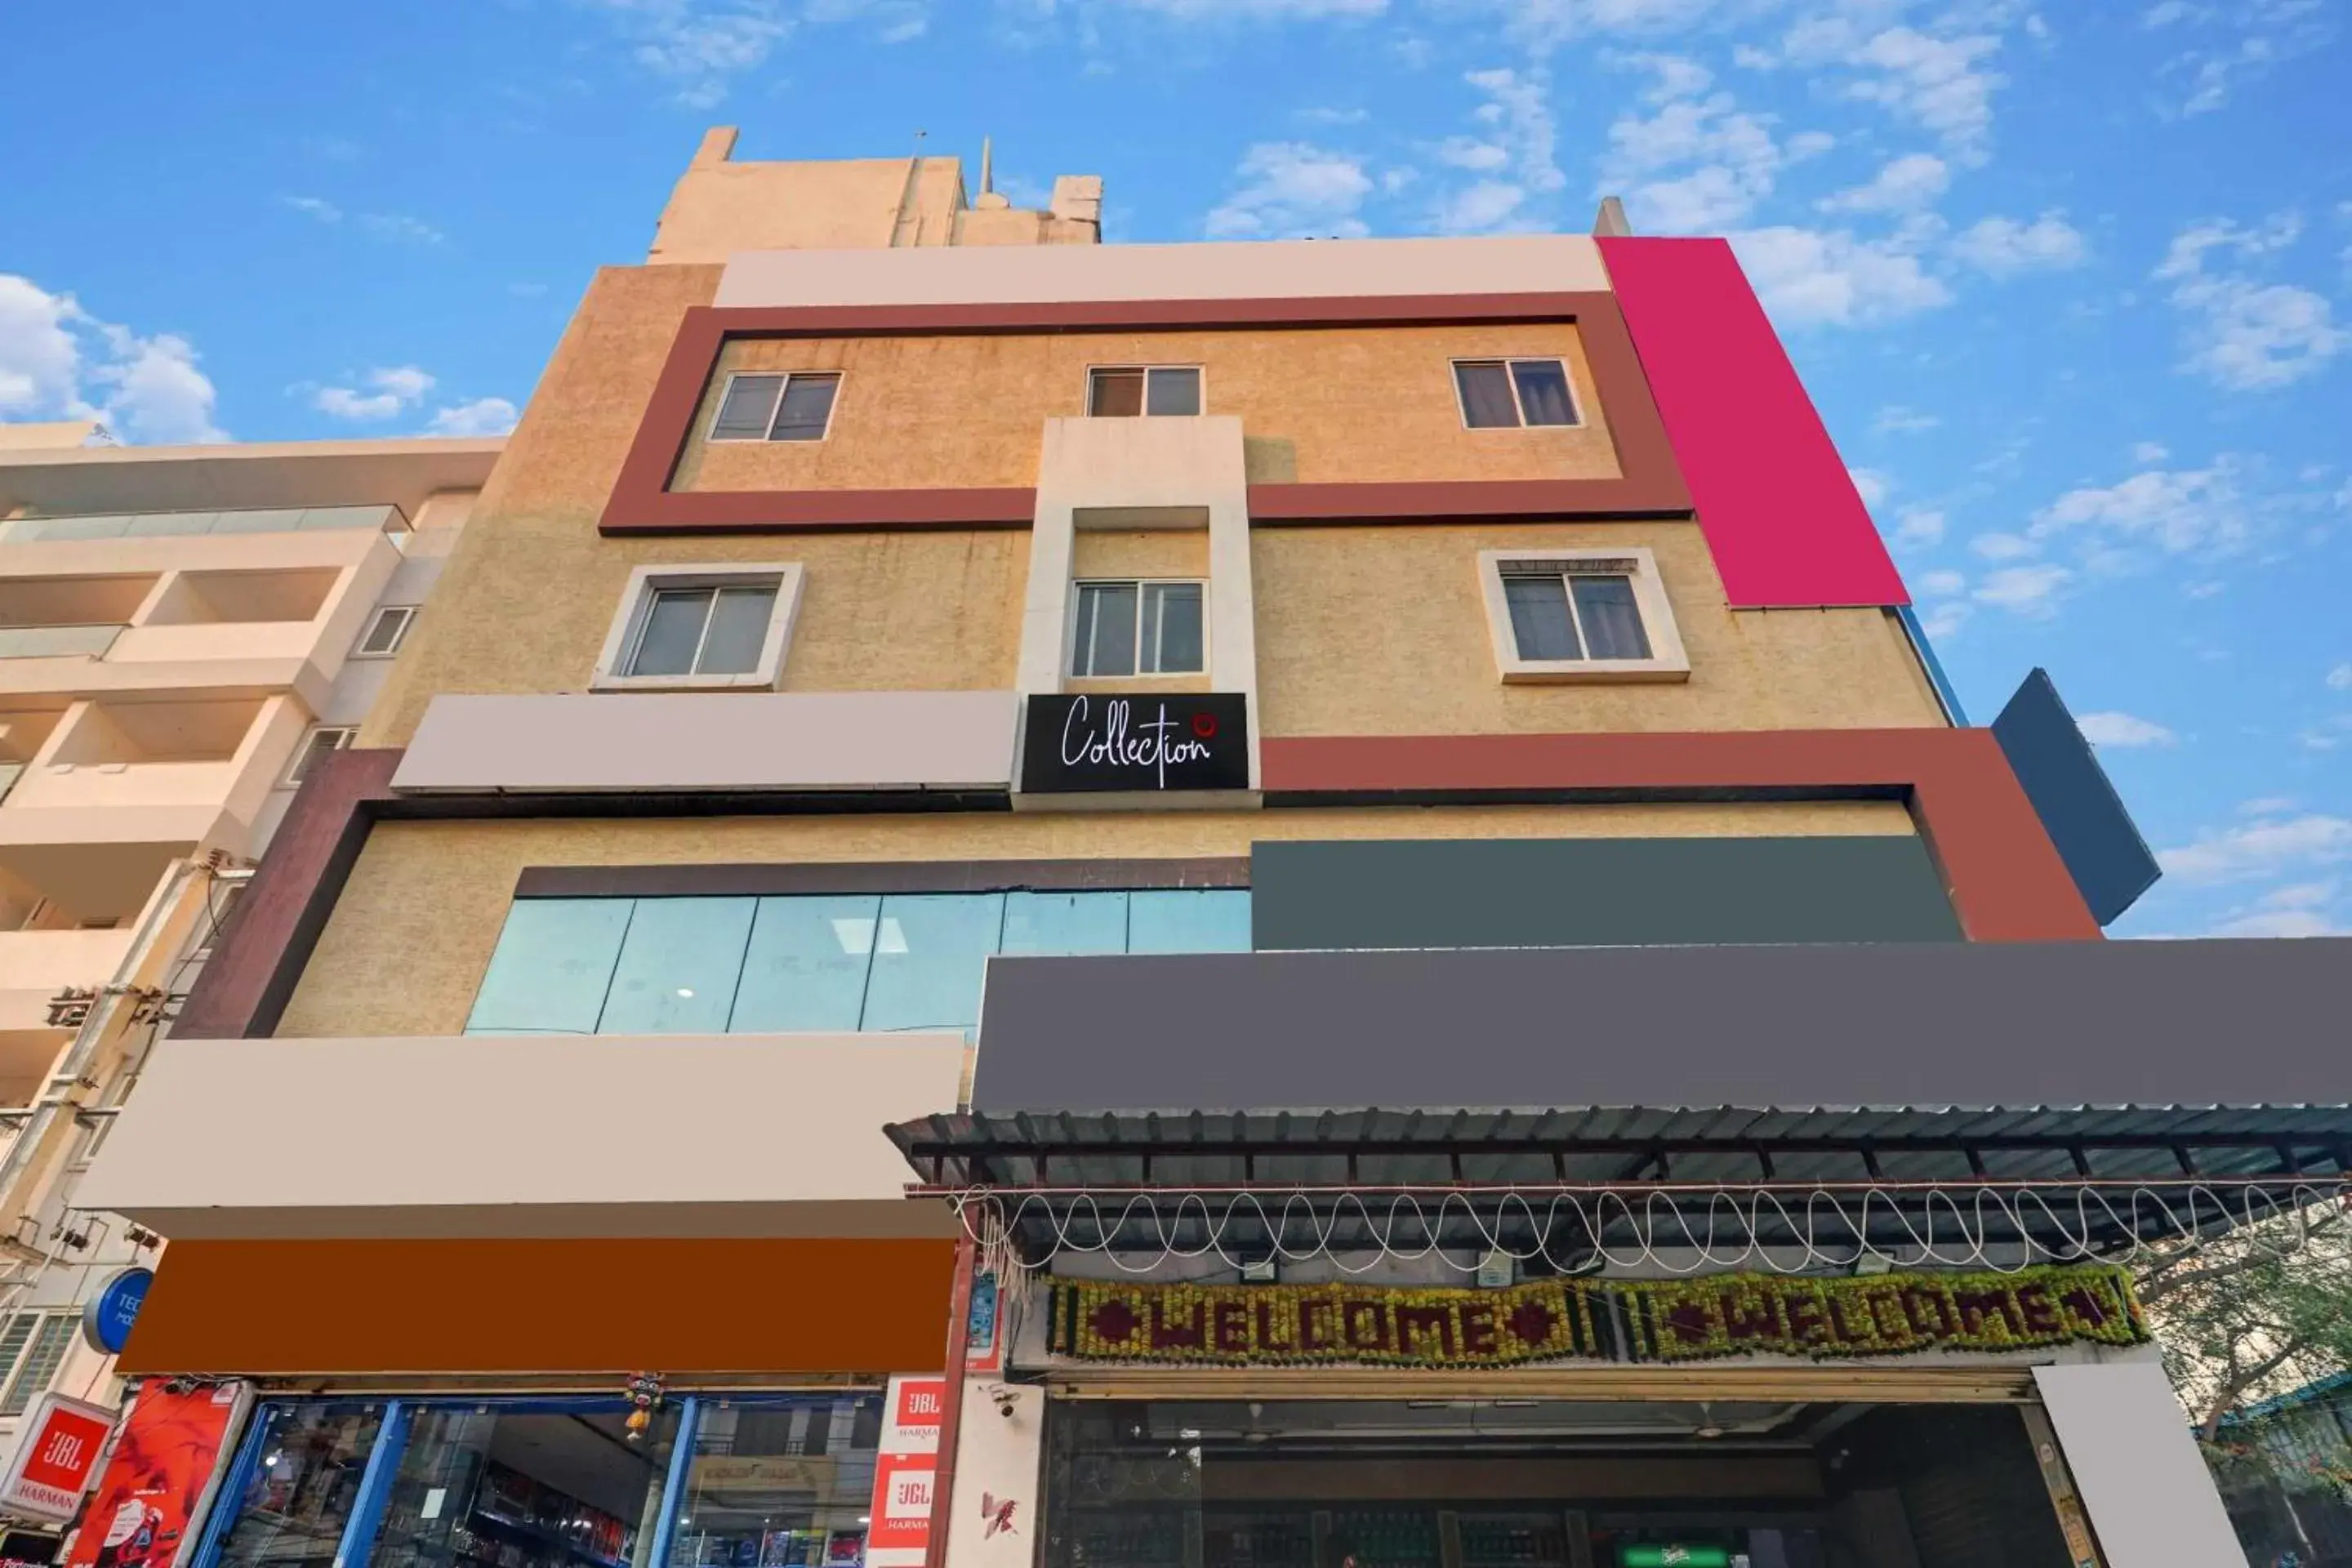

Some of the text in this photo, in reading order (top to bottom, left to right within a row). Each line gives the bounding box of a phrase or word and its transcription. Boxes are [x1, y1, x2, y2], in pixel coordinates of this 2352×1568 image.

[1062, 695, 1210, 790] Collection
[1720, 1285, 2060, 1344] WELCOME
[1152, 1299, 1496, 1356] WELCOME
[909, 1393, 940, 1414] JBL
[898, 1428, 938, 1438] HARMA
[43, 1431, 83, 1472] JBL
[19, 1484, 74, 1509] HARMAN
[898, 1482, 930, 1504] JBL
[888, 1520, 929, 1529] HARMA
